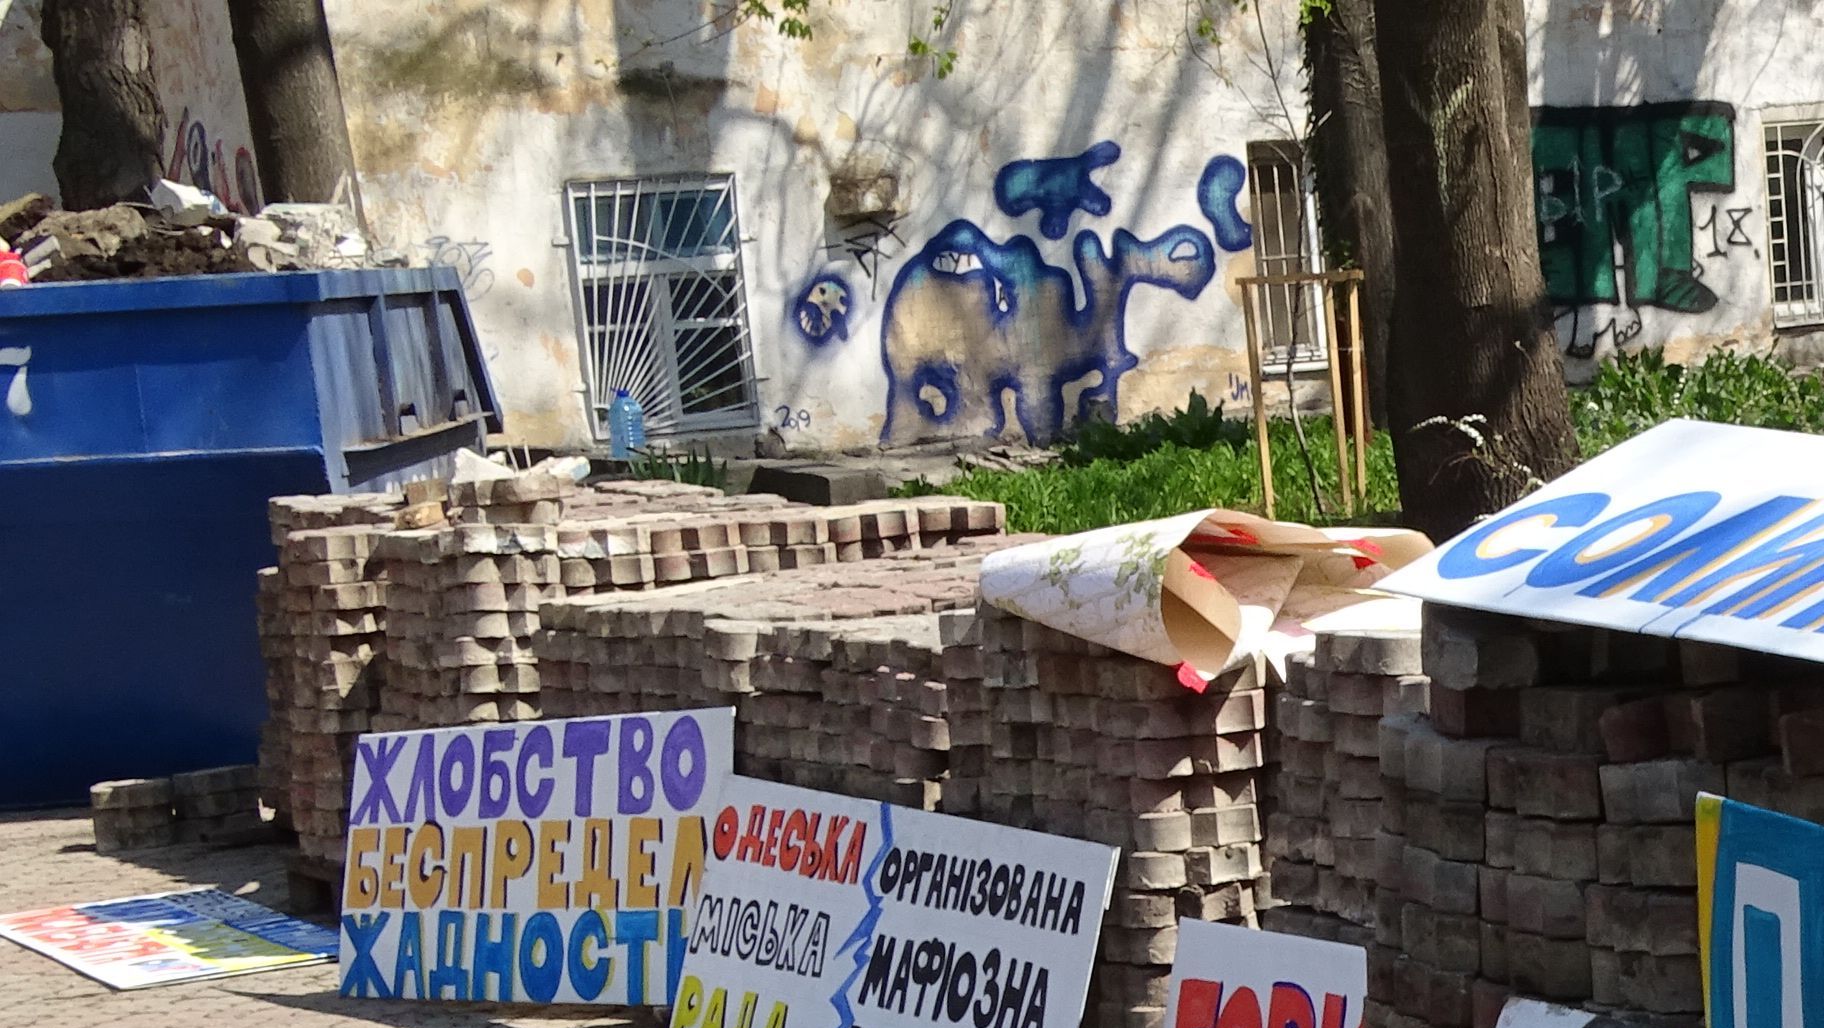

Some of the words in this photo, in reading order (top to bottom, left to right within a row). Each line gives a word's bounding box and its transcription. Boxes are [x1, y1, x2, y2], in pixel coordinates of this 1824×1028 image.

[350, 715, 707, 825] ЖЛОБСТВО
[346, 816, 708, 910] БЕСПРЕДЕЛ
[712, 804, 868, 885] ОДЕСЬКА
[689, 894, 831, 978] МІСЬКА
[879, 847, 1086, 936] ОРГАНІЗОВАНА
